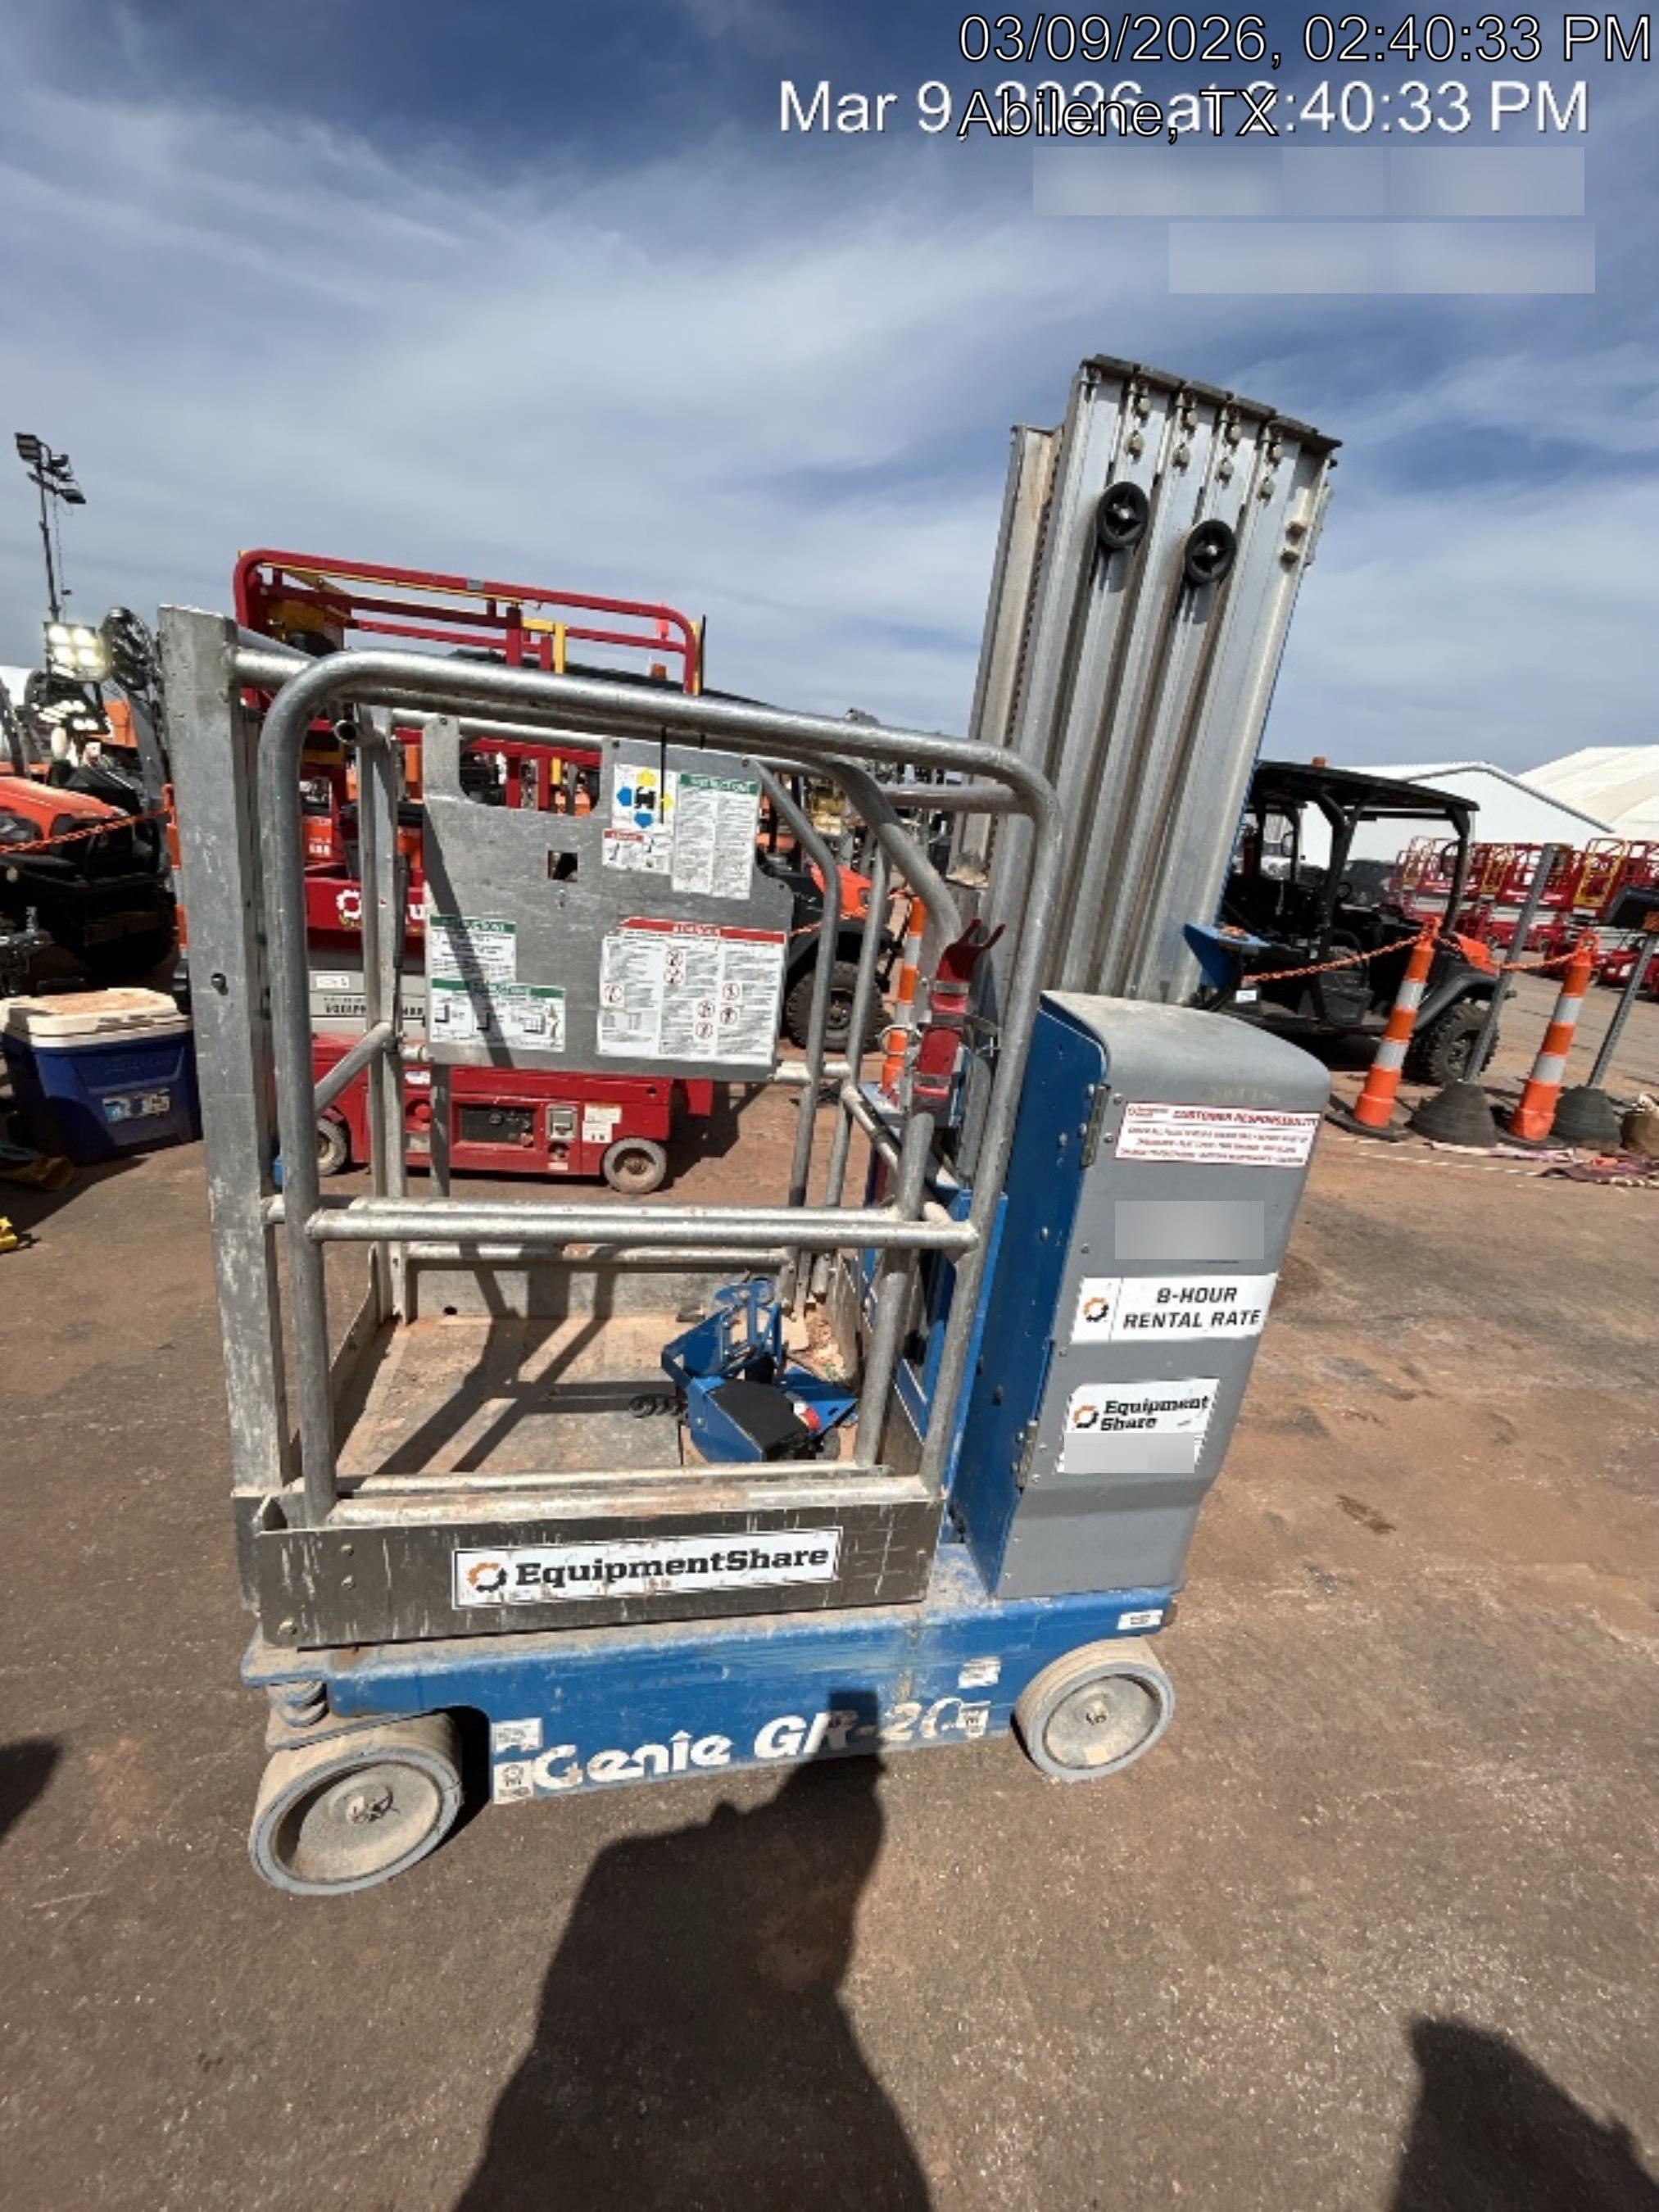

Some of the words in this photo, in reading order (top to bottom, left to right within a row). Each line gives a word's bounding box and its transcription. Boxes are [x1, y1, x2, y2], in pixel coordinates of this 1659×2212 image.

[1157, 1286, 1238, 1304] 8-HOUR
[1123, 1312, 1203, 1330] RENTAL
[1211, 1309, 1262, 1326] RATE
[1104, 1395, 1209, 1416] Equipment
[1100, 1417, 1158, 1431] Share
[515, 1548, 828, 1587] EquipmentShare
